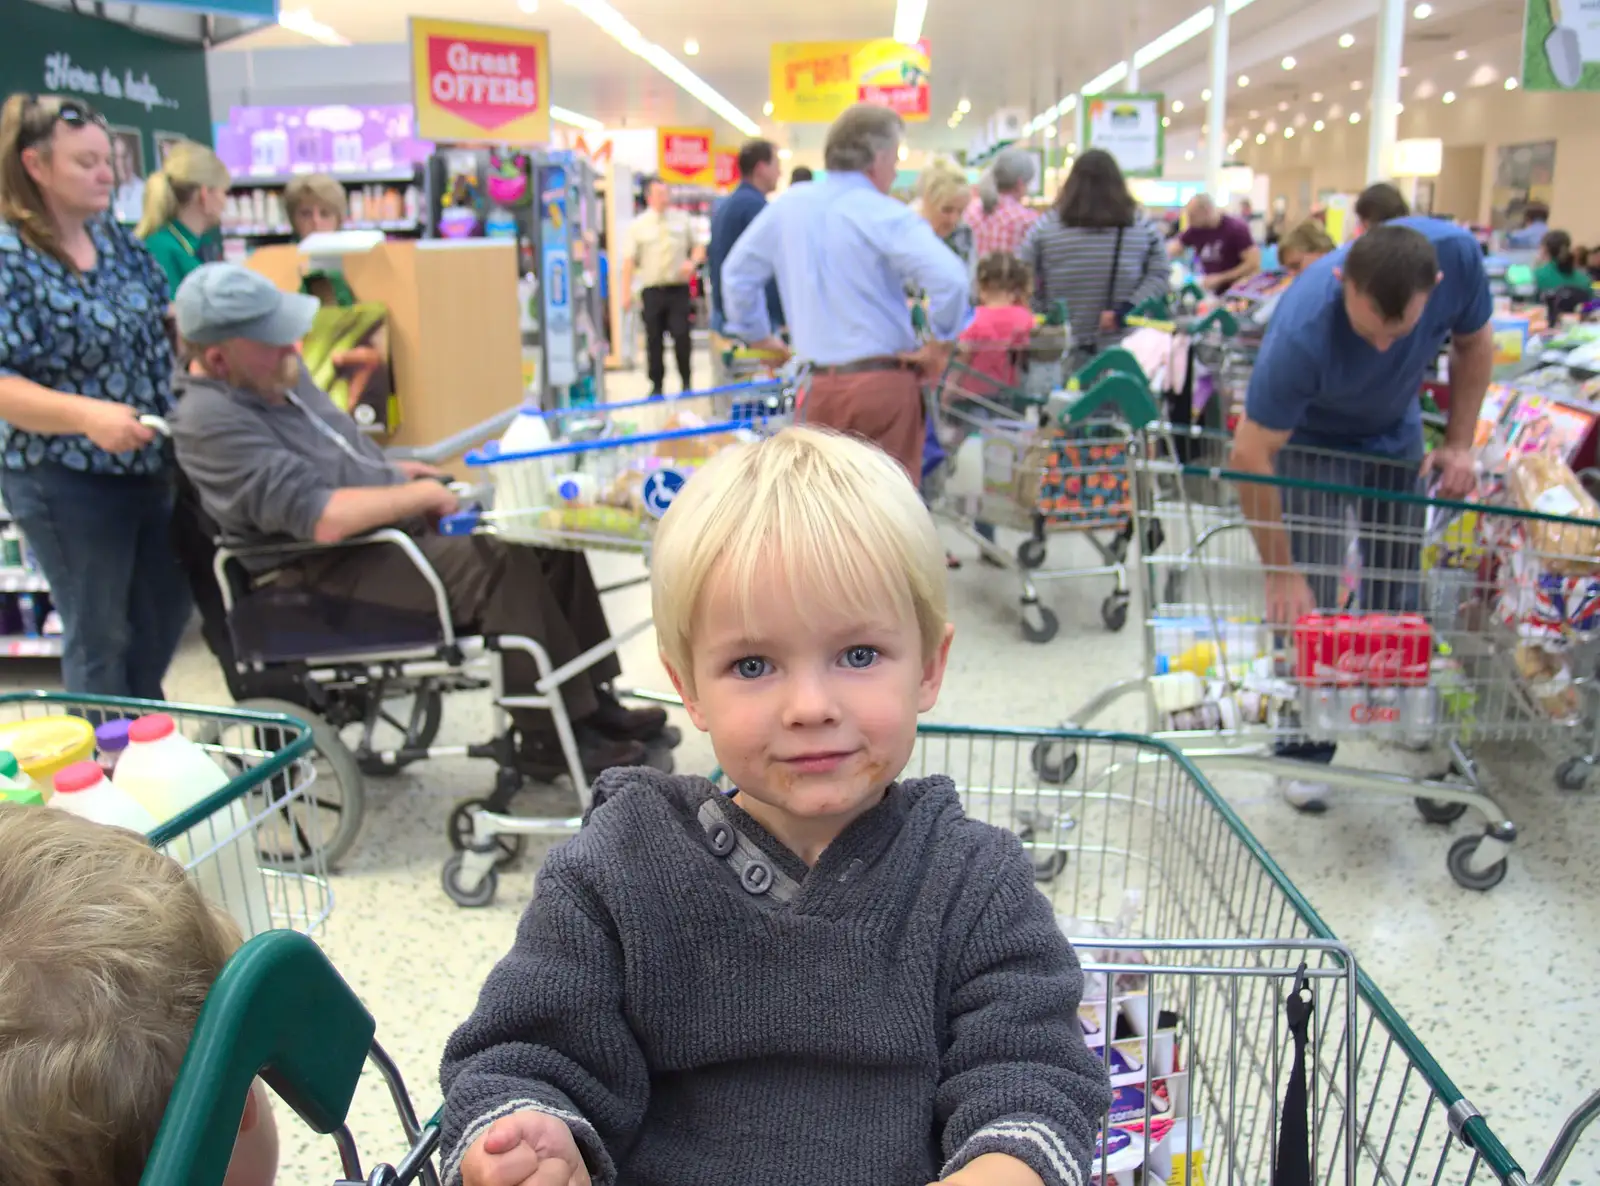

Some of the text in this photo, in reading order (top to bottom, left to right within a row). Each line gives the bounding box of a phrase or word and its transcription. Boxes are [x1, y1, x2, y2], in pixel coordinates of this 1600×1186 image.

[45, 52, 99, 94] Here
[101, 66, 122, 98] to
[446, 42, 519, 76] Great
[432, 71, 535, 105] OFFERS
